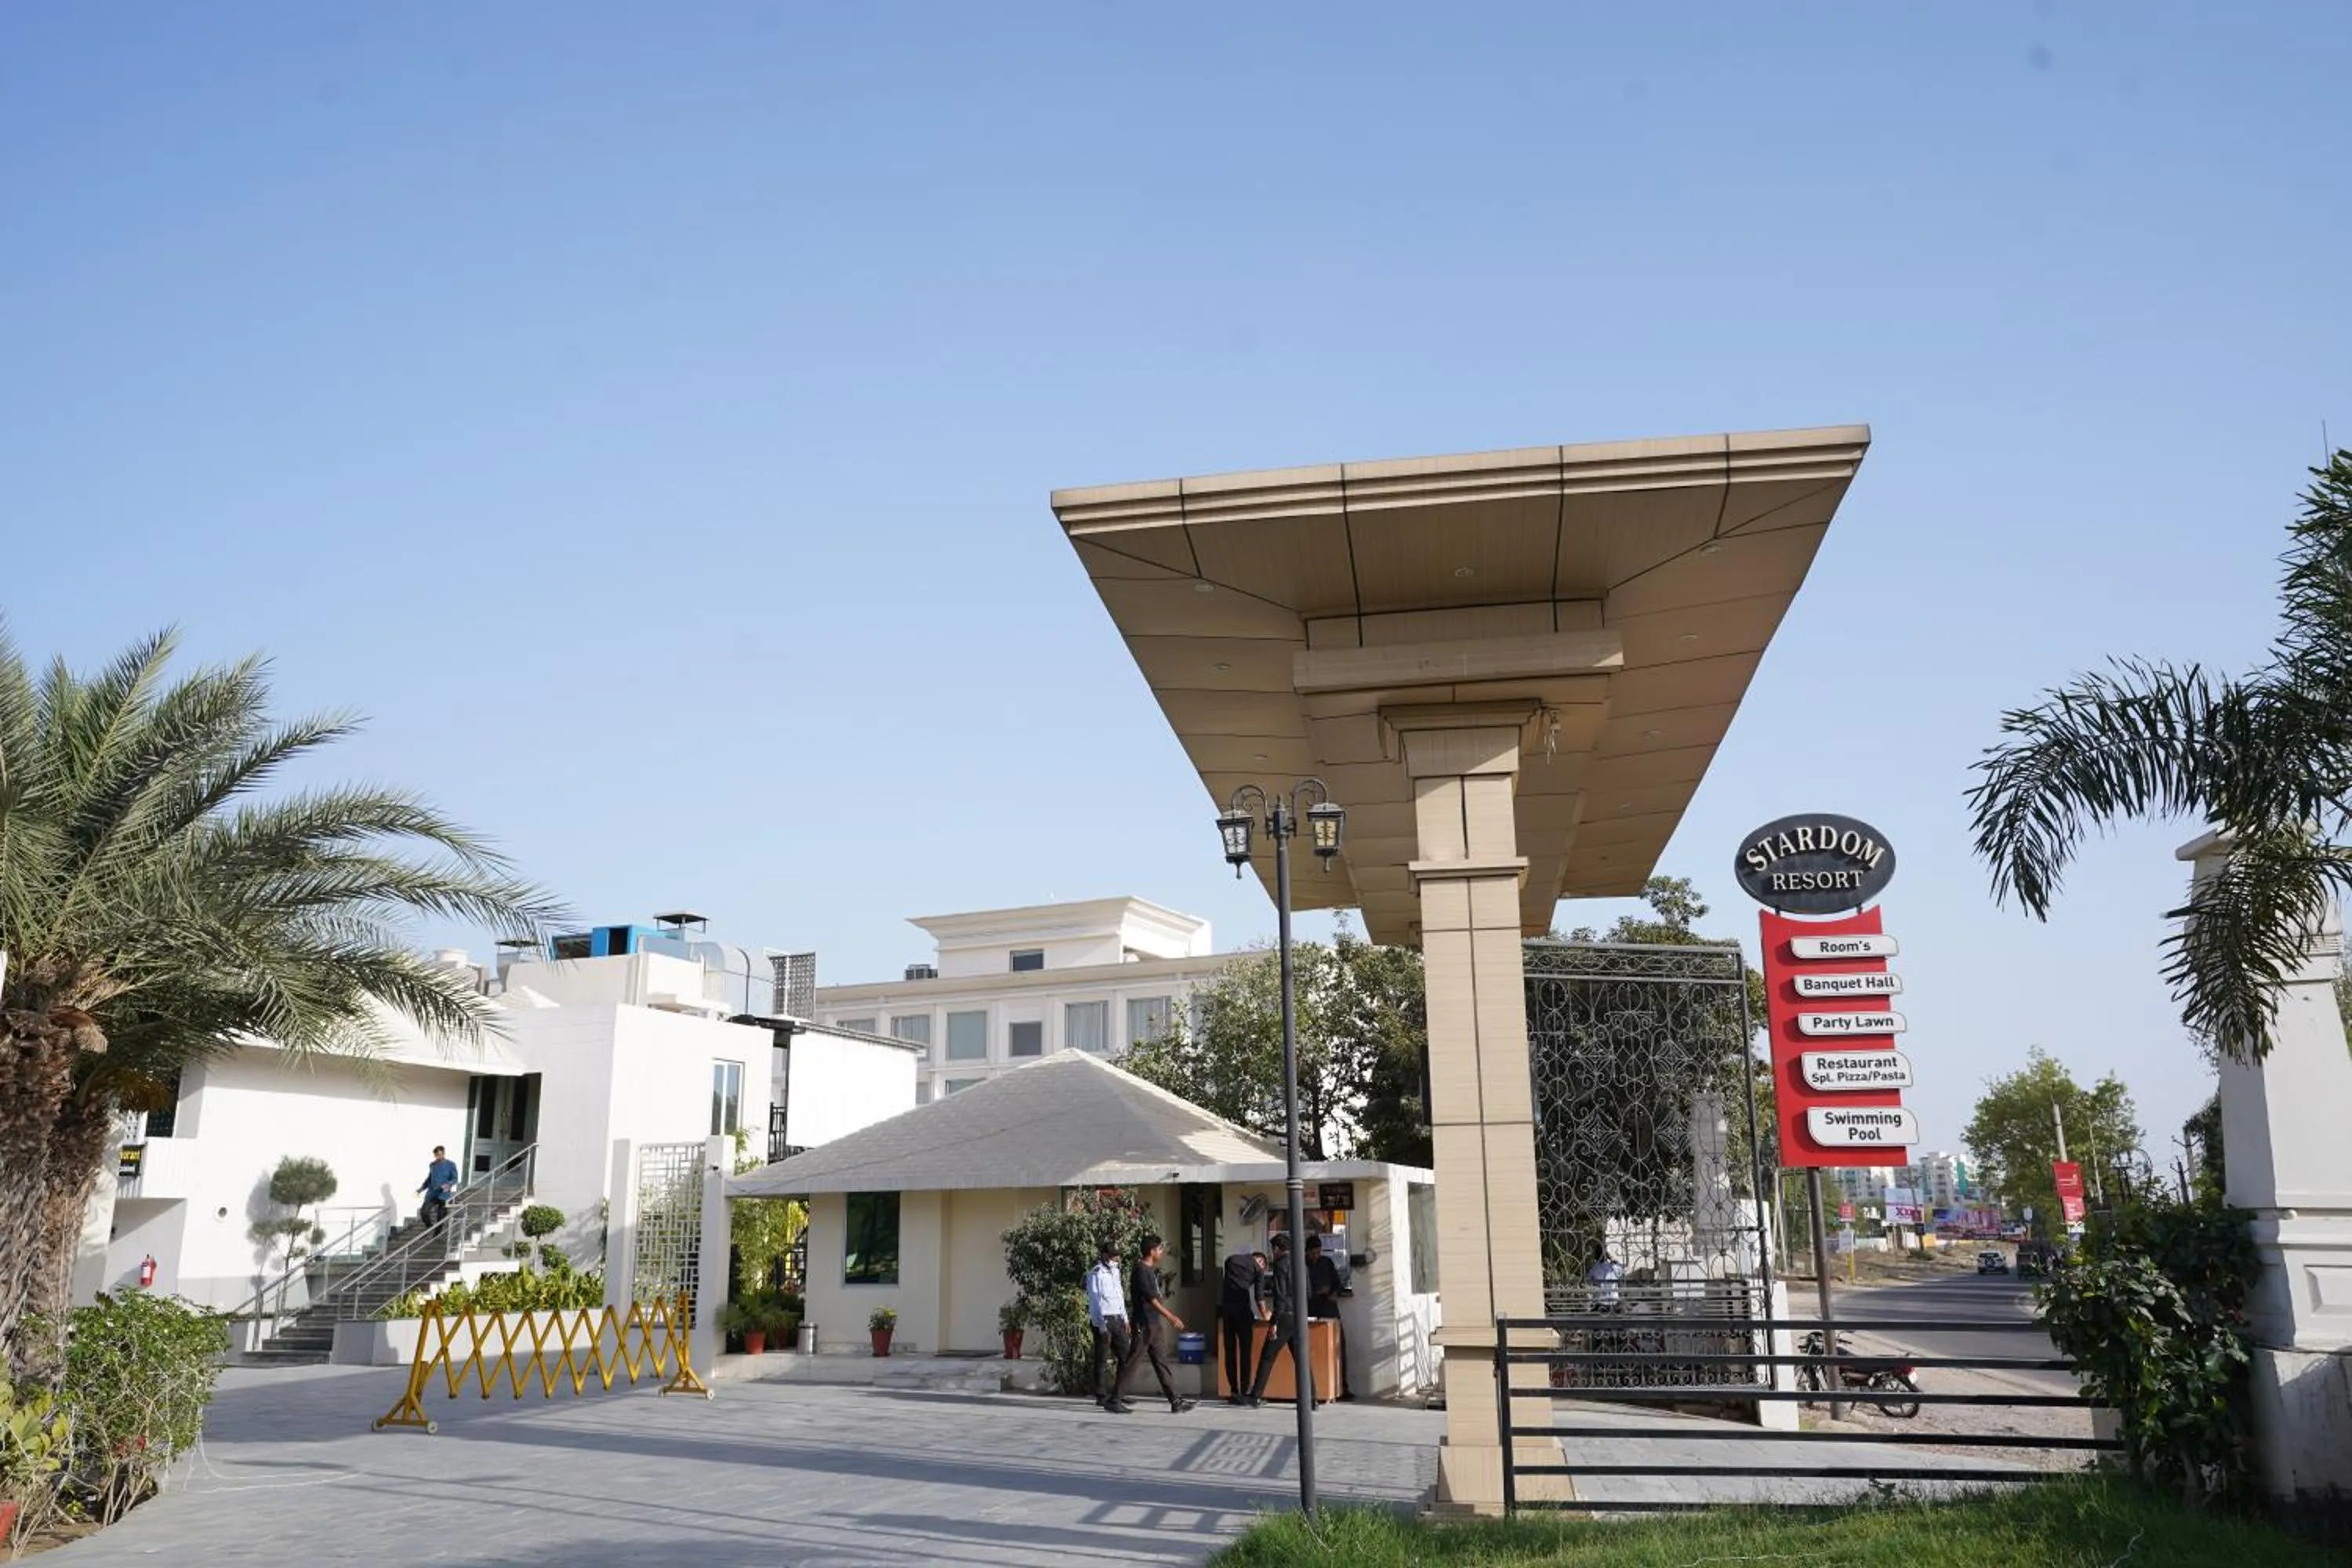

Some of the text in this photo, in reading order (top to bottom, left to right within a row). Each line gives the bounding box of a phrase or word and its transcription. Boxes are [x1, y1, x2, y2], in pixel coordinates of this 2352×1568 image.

[1746, 826, 1885, 871] STARDOM
[1773, 870, 1864, 891] RESORT
[1820, 941, 1871, 953] Room's
[1804, 977, 1894, 991] Banquet Hall
[1813, 1016, 1893, 1029] Party Lawn
[1817, 1057, 1898, 1069] Restaurant
[1837, 1071, 1906, 1082] Pizza/Pasta
[1824, 1112, 1902, 1127] Swimming
[1848, 1127, 1882, 1141] Pool
